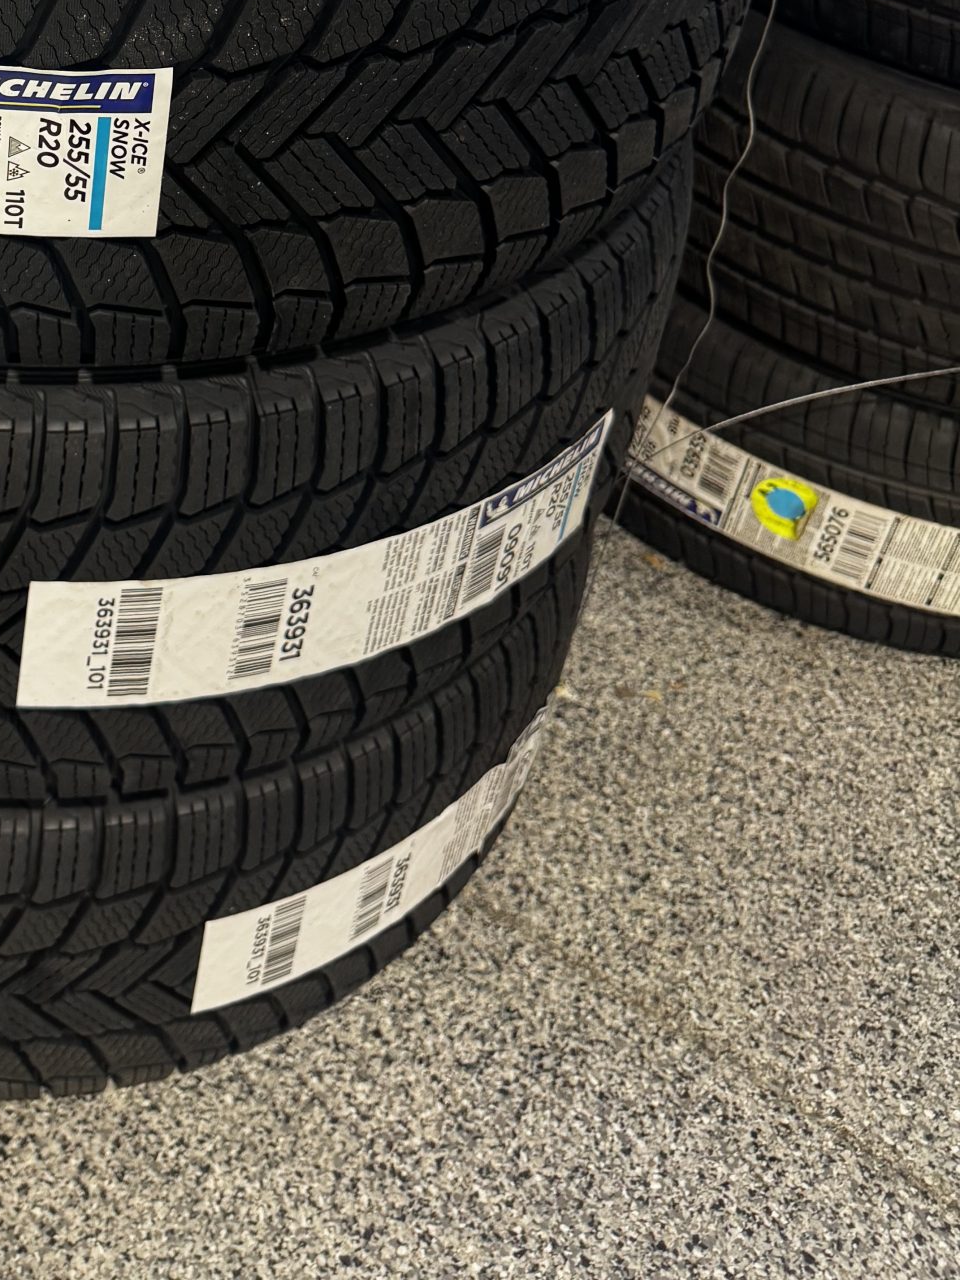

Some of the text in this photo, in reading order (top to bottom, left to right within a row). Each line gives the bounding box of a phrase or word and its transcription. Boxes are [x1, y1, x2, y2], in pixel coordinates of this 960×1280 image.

[37, 118, 61, 168] R20
[64, 120, 92, 202] 255/55
[110, 118, 130, 179] SNOW
[3, 189, 25, 229] 110T
[545, 483, 562, 518] R20
[552, 473, 575, 531] 255/55
[494, 522, 522, 592] 09091
[814, 506, 849, 563] 565076
[86, 596, 116, 691] 363931_101
[279, 584, 315, 662] 363931
